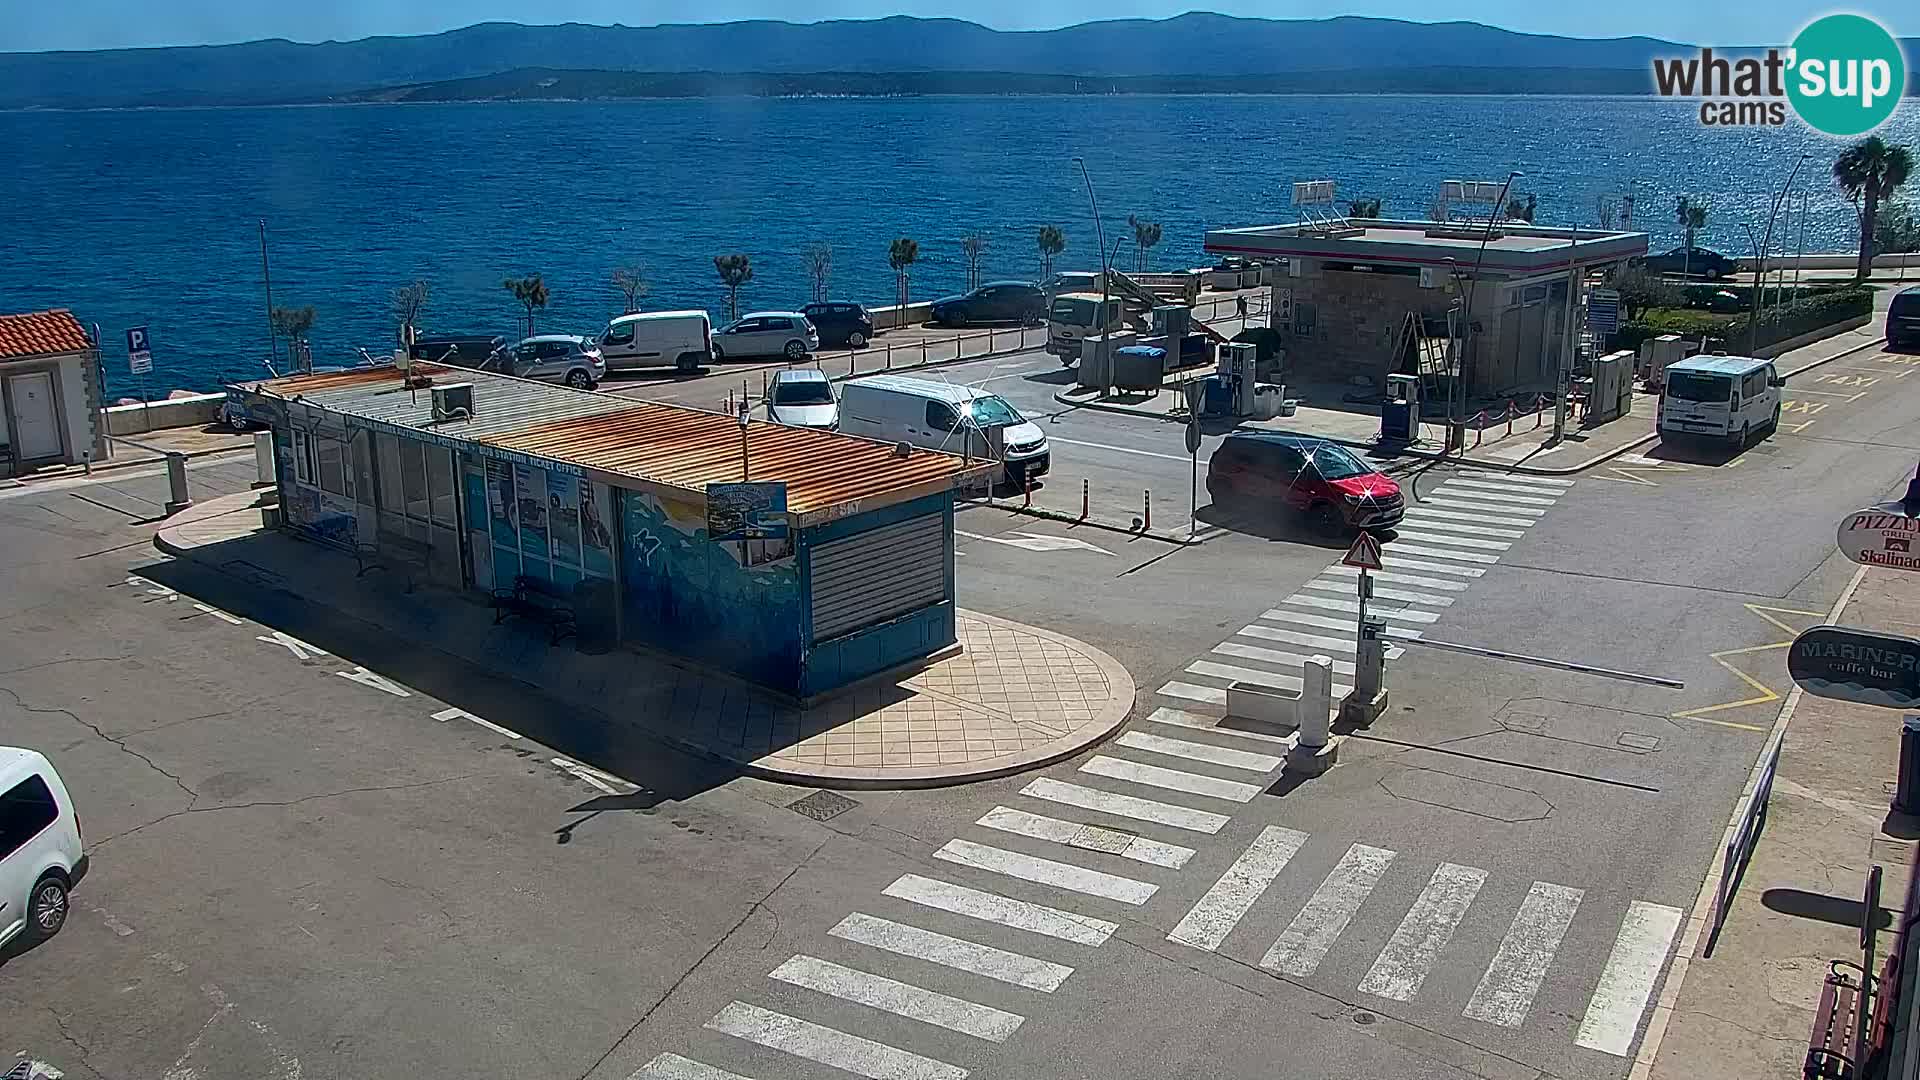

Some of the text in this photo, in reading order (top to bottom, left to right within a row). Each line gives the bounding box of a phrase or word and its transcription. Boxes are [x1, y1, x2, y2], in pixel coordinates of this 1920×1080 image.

[131, 331, 143, 349] P
[1815, 374, 1880, 387] TAXI
[496, 449, 527, 465] STATION
[530, 456, 555, 471] TICKET
[556, 461, 583, 477] OFFICE
[1848, 515, 1920, 534] PIZZE
[1881, 530, 1917, 540] GRILL
[1870, 666, 1897, 679] bar
